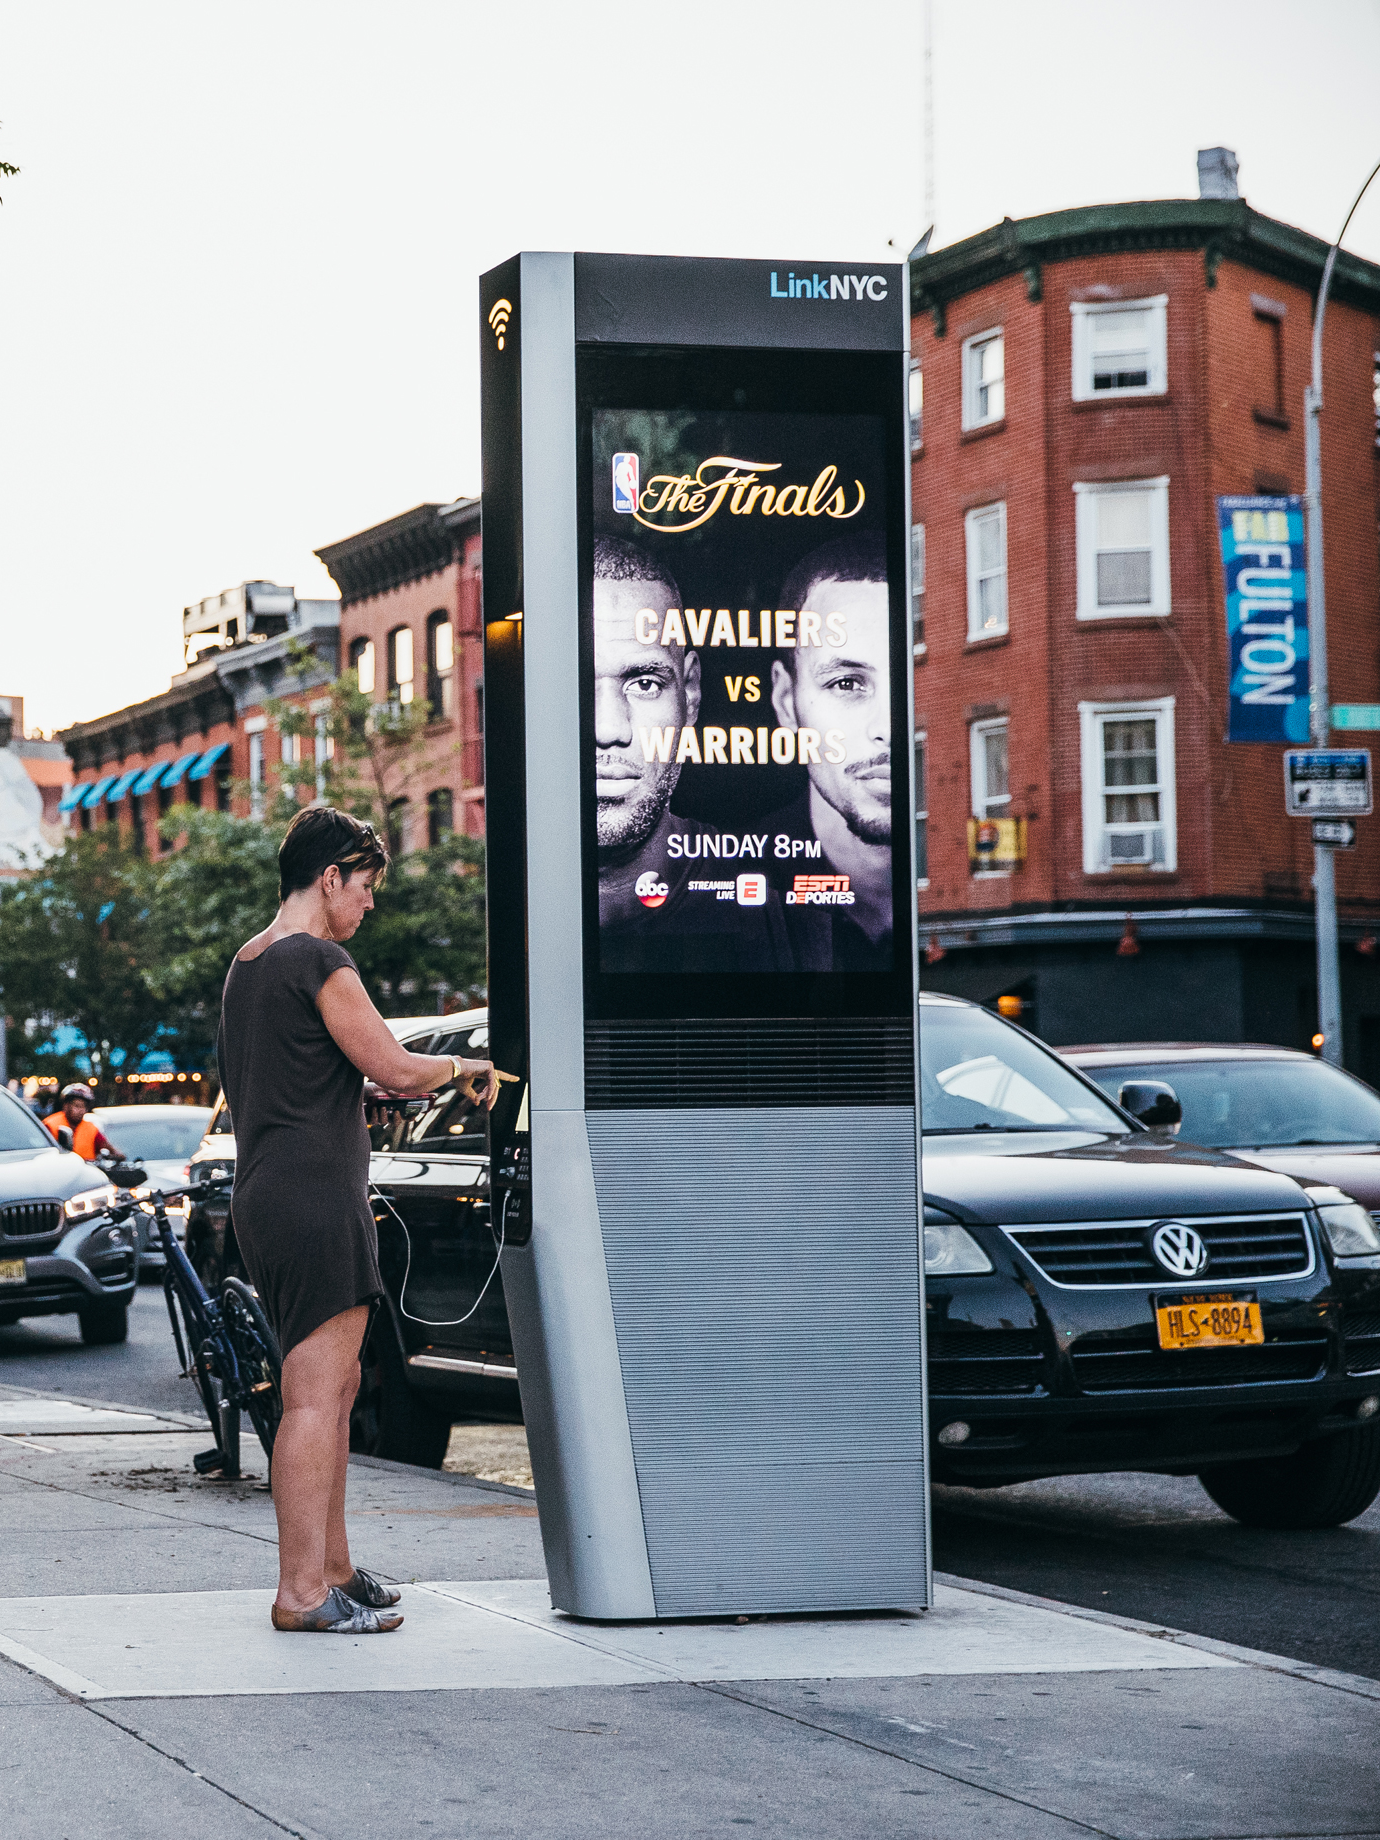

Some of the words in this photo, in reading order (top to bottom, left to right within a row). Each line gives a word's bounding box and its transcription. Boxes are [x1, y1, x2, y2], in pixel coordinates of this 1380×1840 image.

[770, 271, 888, 301] LinkNYC
[633, 456, 866, 532] Finals
[639, 474, 707, 513] The
[634, 608, 849, 648] CAVALIERS
[1234, 541, 1297, 705] FULTON
[724, 676, 761, 702] VS
[638, 726, 849, 765] WARRIORS
[667, 834, 768, 859] SUNDAY
[773, 834, 821, 859] 8PM
[688, 880, 735, 891] STREAMING
[716, 891, 735, 900] LIVE
[793, 875, 850, 892] ESPN
[785, 892, 855, 905] DEPORTES
